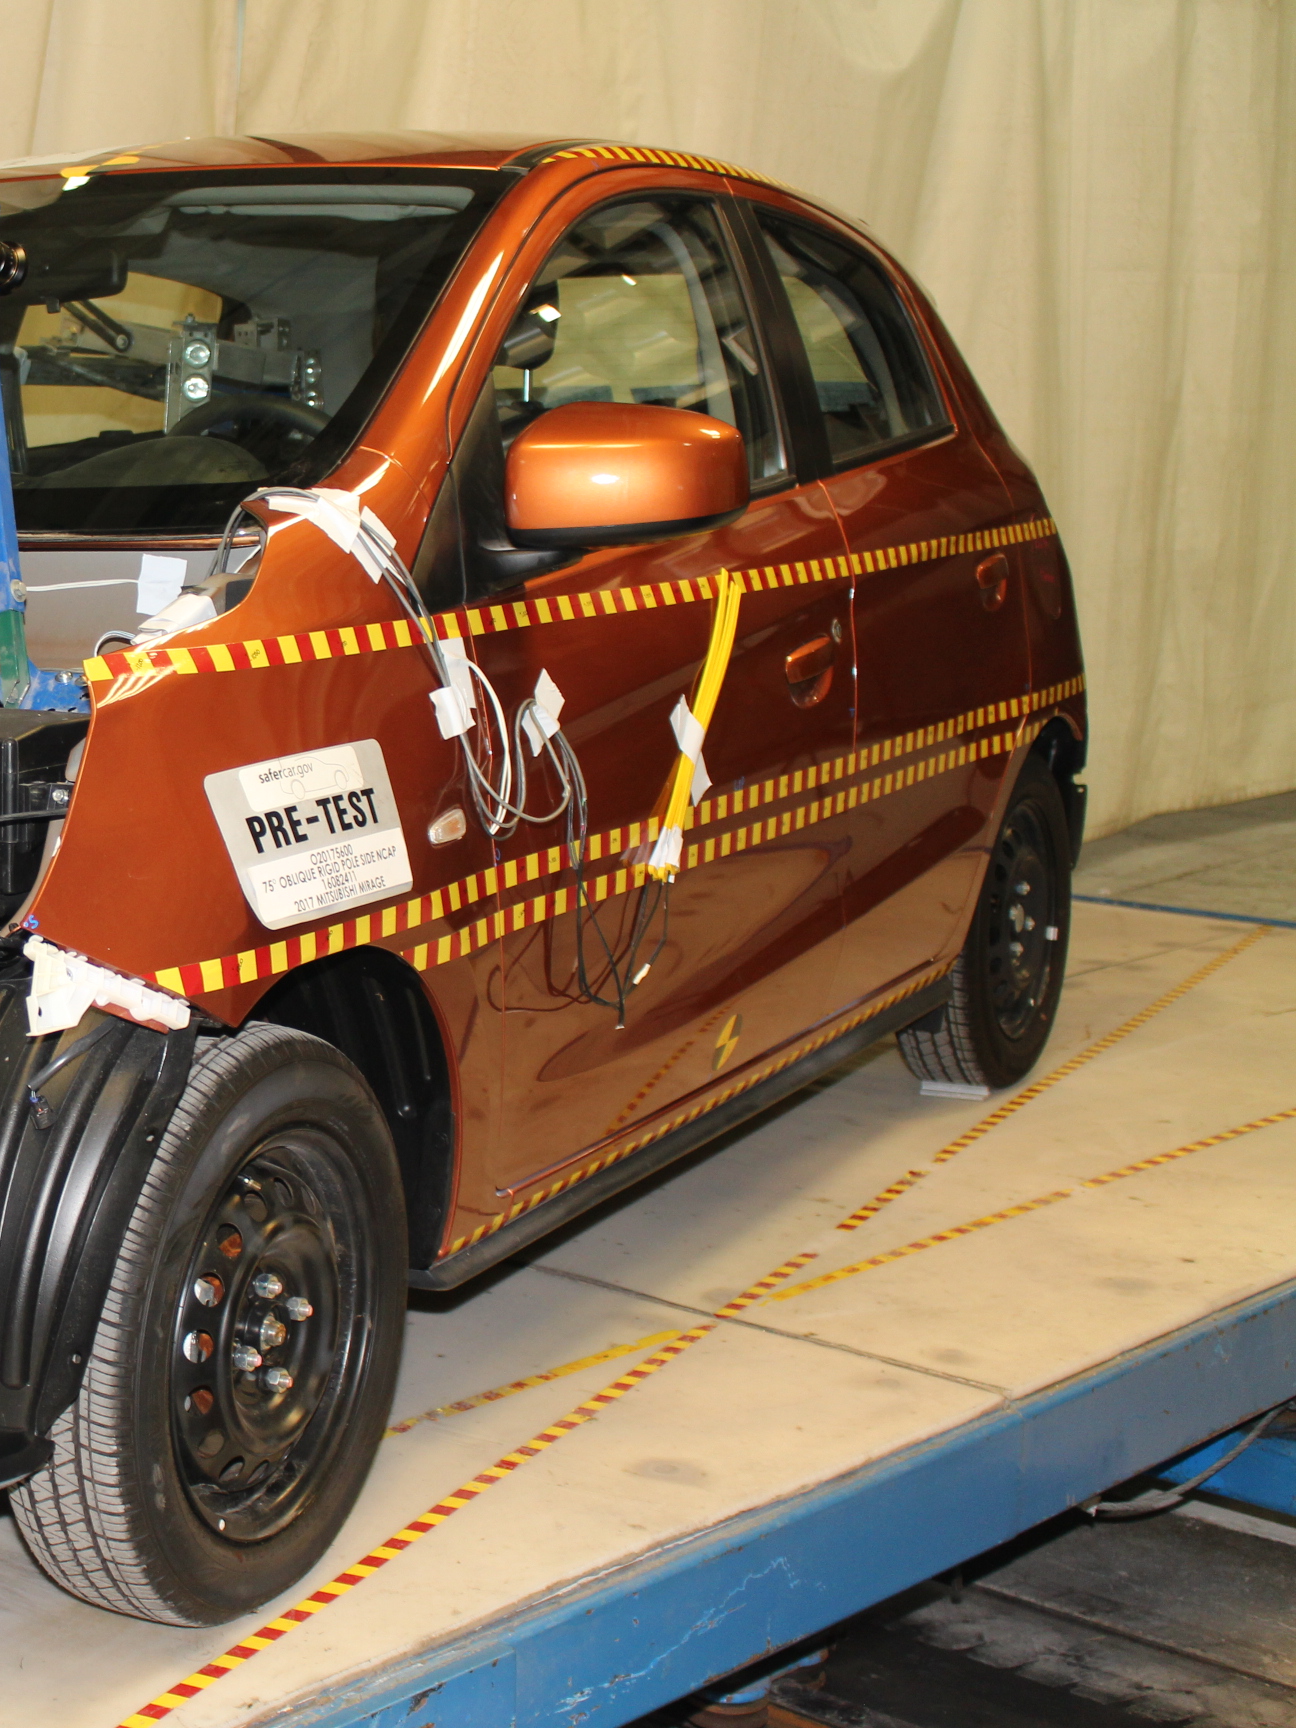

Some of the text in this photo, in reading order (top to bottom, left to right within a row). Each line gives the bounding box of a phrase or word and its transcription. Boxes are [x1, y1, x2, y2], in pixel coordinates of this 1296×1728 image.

[258, 762, 313, 784] safercar.gov
[245, 787, 379, 854] PRE-TEST
[279, 867, 317, 889] OBLIQUE
[318, 862, 341, 878] RIGID
[341, 856, 360, 872] POLE
[360, 850, 376, 866] SIDE
[377, 845, 397, 861] NCAP
[294, 875, 386, 913] 2017 MITSUBISHI MIRAGE
